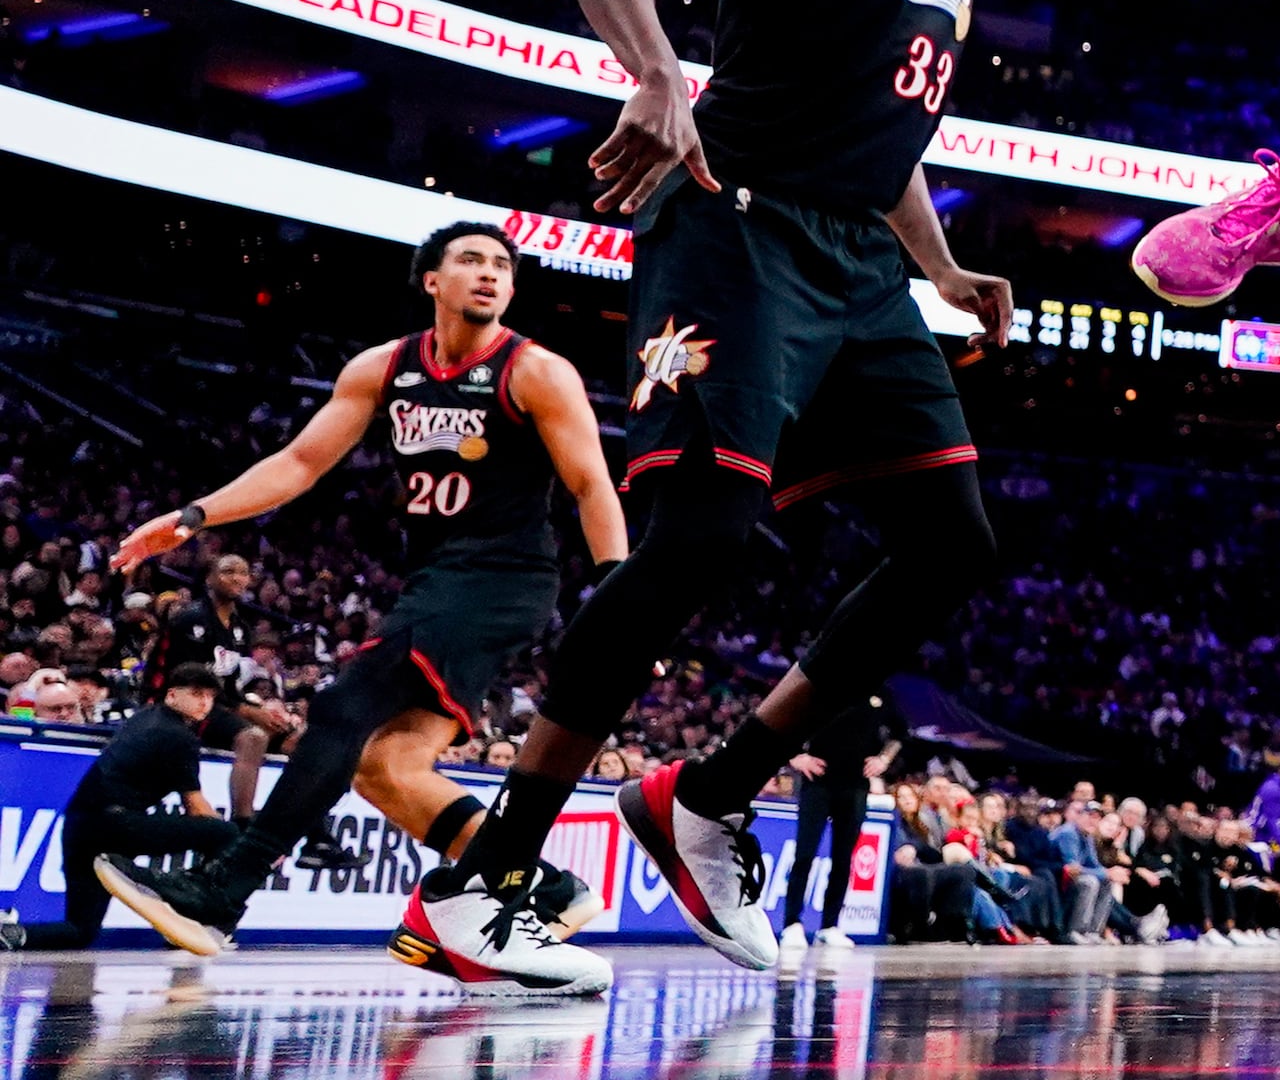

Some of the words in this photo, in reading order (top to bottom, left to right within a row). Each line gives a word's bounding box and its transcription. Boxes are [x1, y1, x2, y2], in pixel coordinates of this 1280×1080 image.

[894, 32, 954, 114] 33
[939, 131, 1058, 167] WITH
[1072, 154, 1195, 189] JOHN
[407, 471, 470, 517] 20
